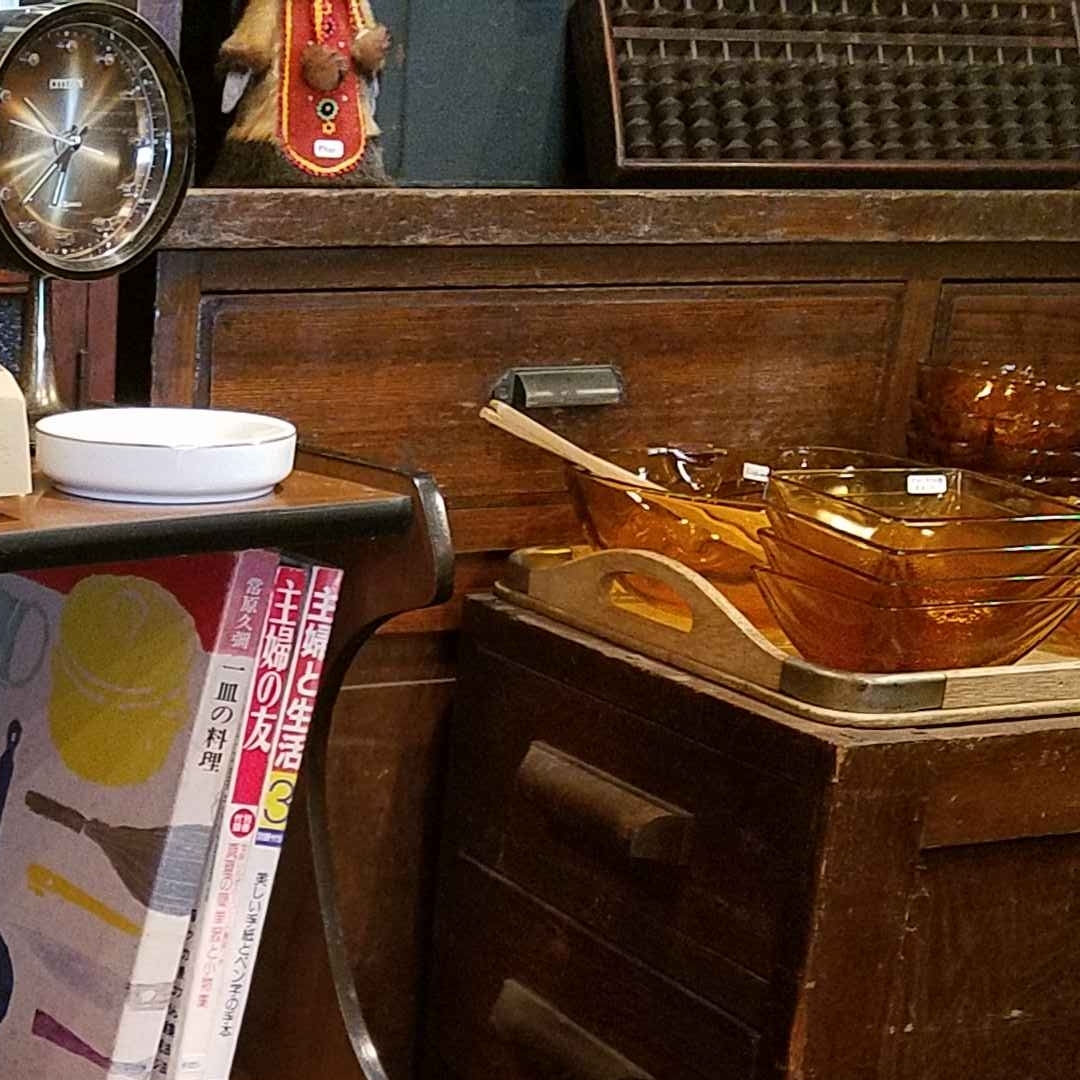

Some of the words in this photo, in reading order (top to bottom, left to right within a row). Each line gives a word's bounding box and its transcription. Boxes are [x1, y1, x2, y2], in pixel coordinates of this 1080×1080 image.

[198, 664, 246, 773] 一皿の料理
[243, 579, 302, 753] 主婦の友
[274, 588, 337, 772] 主婦と生活
[263, 779, 294, 825] 3
